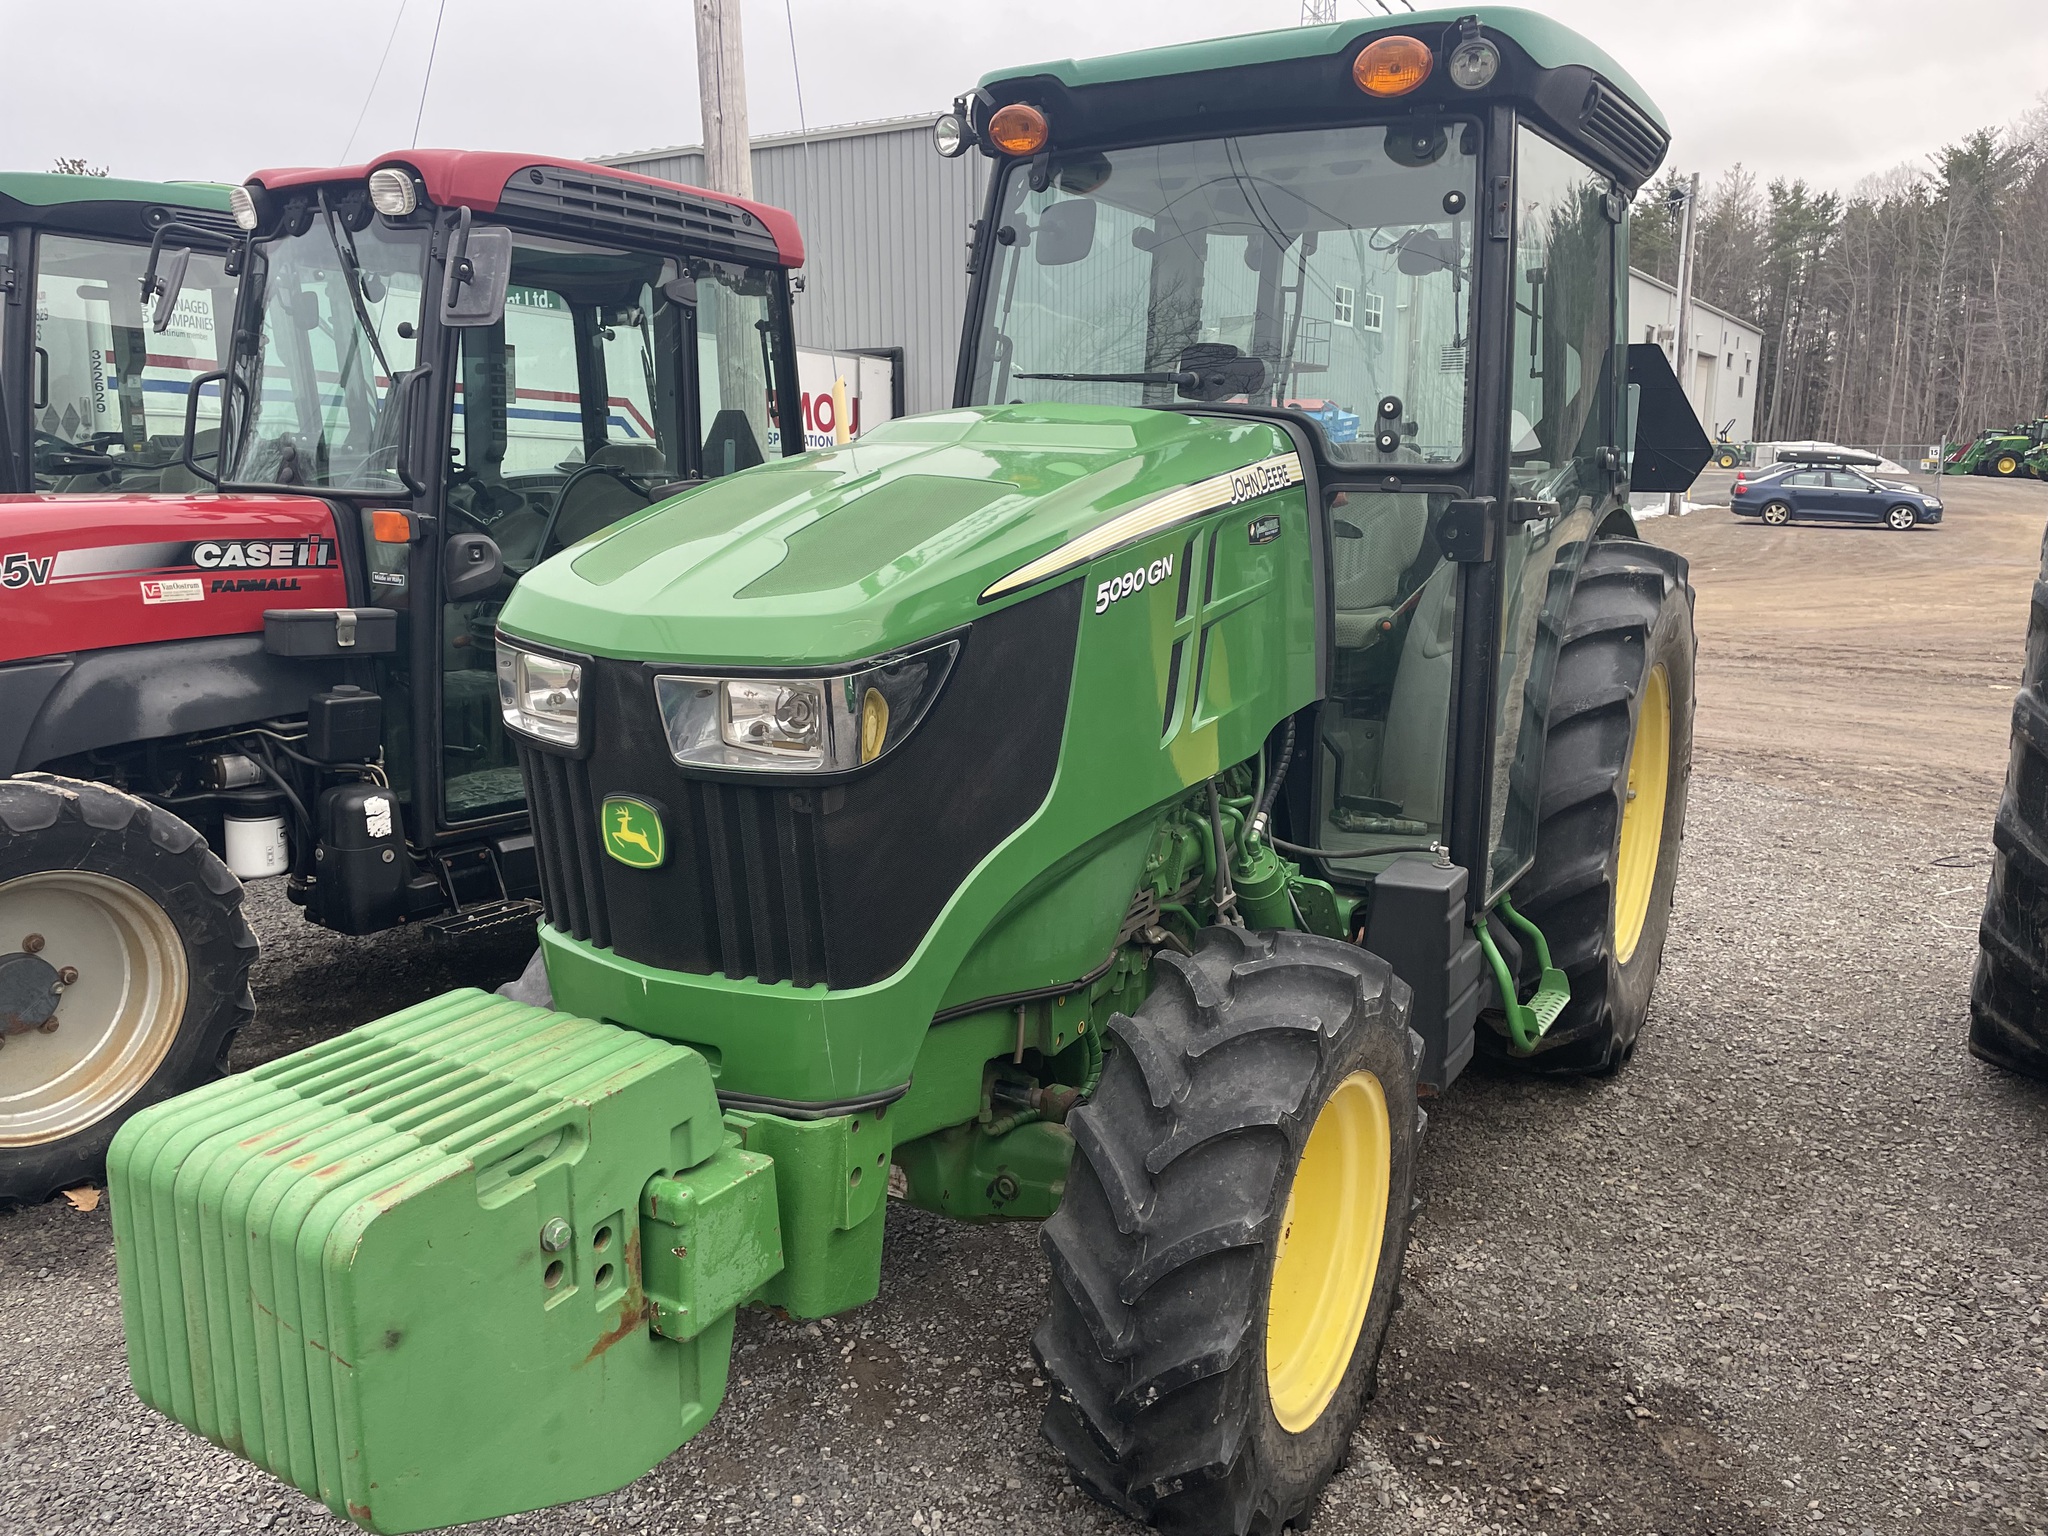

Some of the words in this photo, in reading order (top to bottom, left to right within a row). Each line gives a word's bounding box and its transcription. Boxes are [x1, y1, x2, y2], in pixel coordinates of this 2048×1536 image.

[0, 552, 53, 589] 5V
[192, 540, 296, 569] CASE
[211, 578, 301, 593] FARMALL
[1095, 567, 1146, 615] 5090
[1147, 553, 1174, 586] GN
